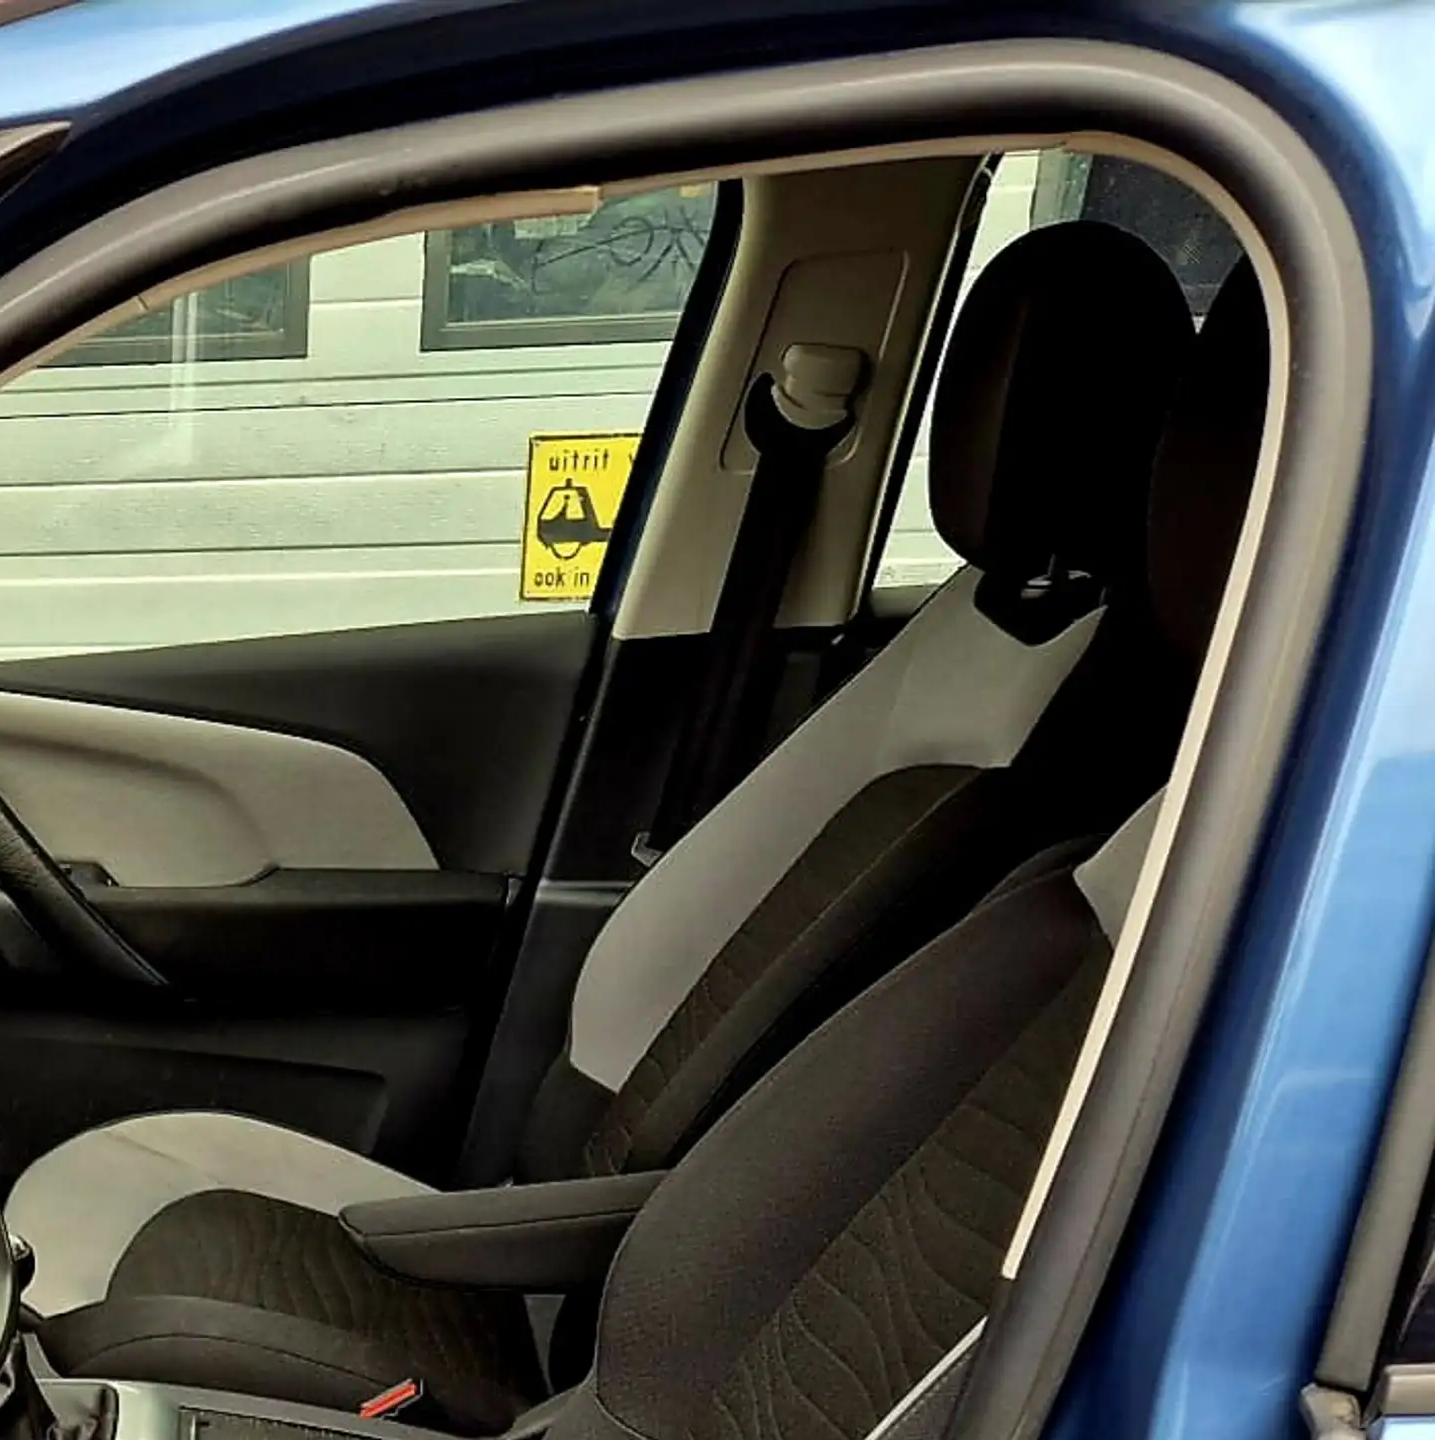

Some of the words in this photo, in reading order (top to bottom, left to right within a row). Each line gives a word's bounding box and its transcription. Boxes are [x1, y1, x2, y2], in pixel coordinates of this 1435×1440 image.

[548, 449, 610, 471] uitrit
[534, 566, 566, 587] ook
[573, 567, 590, 586] in
